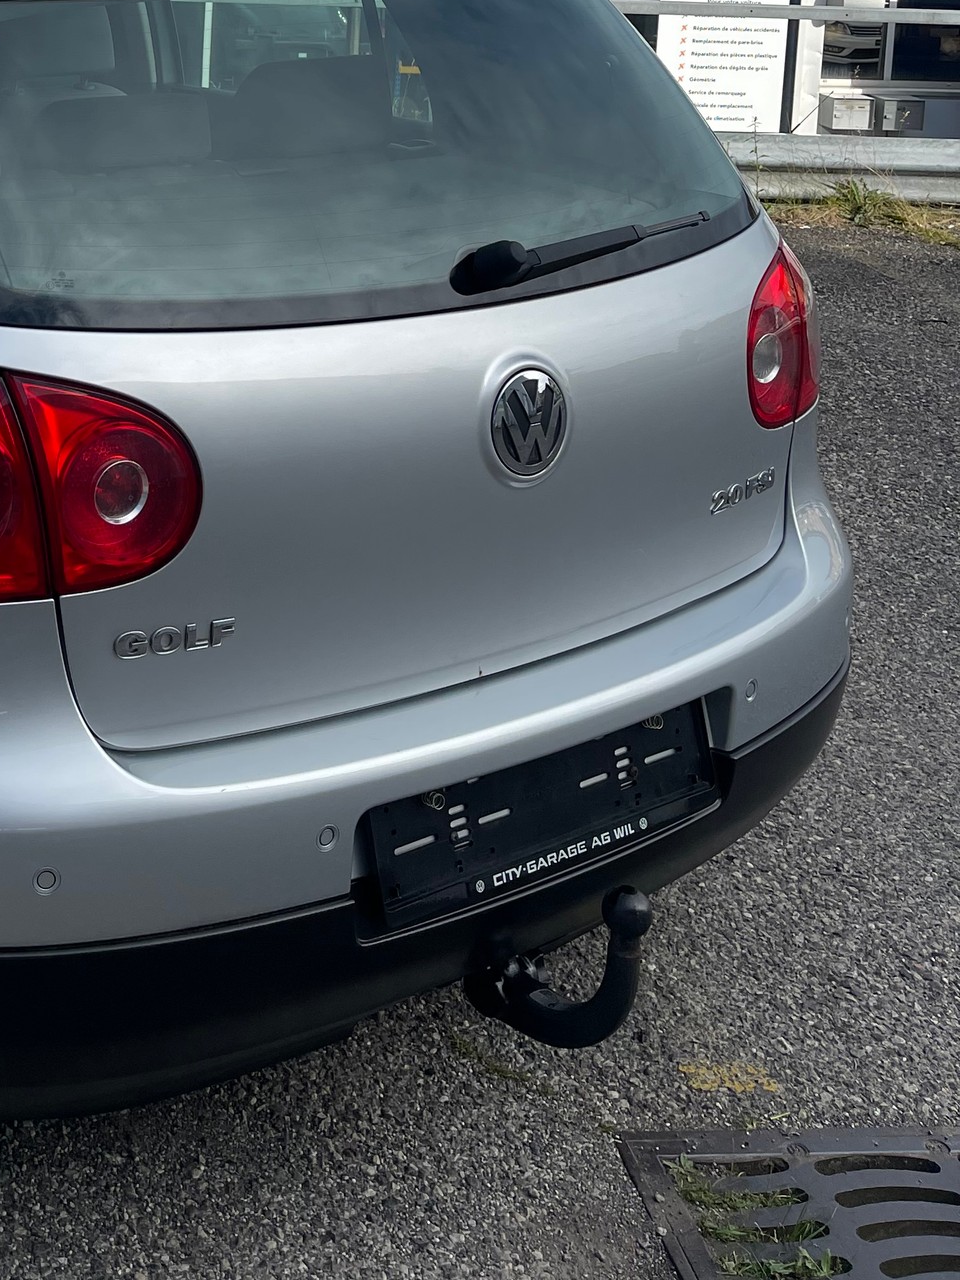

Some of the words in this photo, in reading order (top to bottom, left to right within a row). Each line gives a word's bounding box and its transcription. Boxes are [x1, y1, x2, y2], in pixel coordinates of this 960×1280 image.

[113, 617, 235, 660] GOLF
[592, 831, 611, 848] AG
[613, 823, 635, 840] WIL
